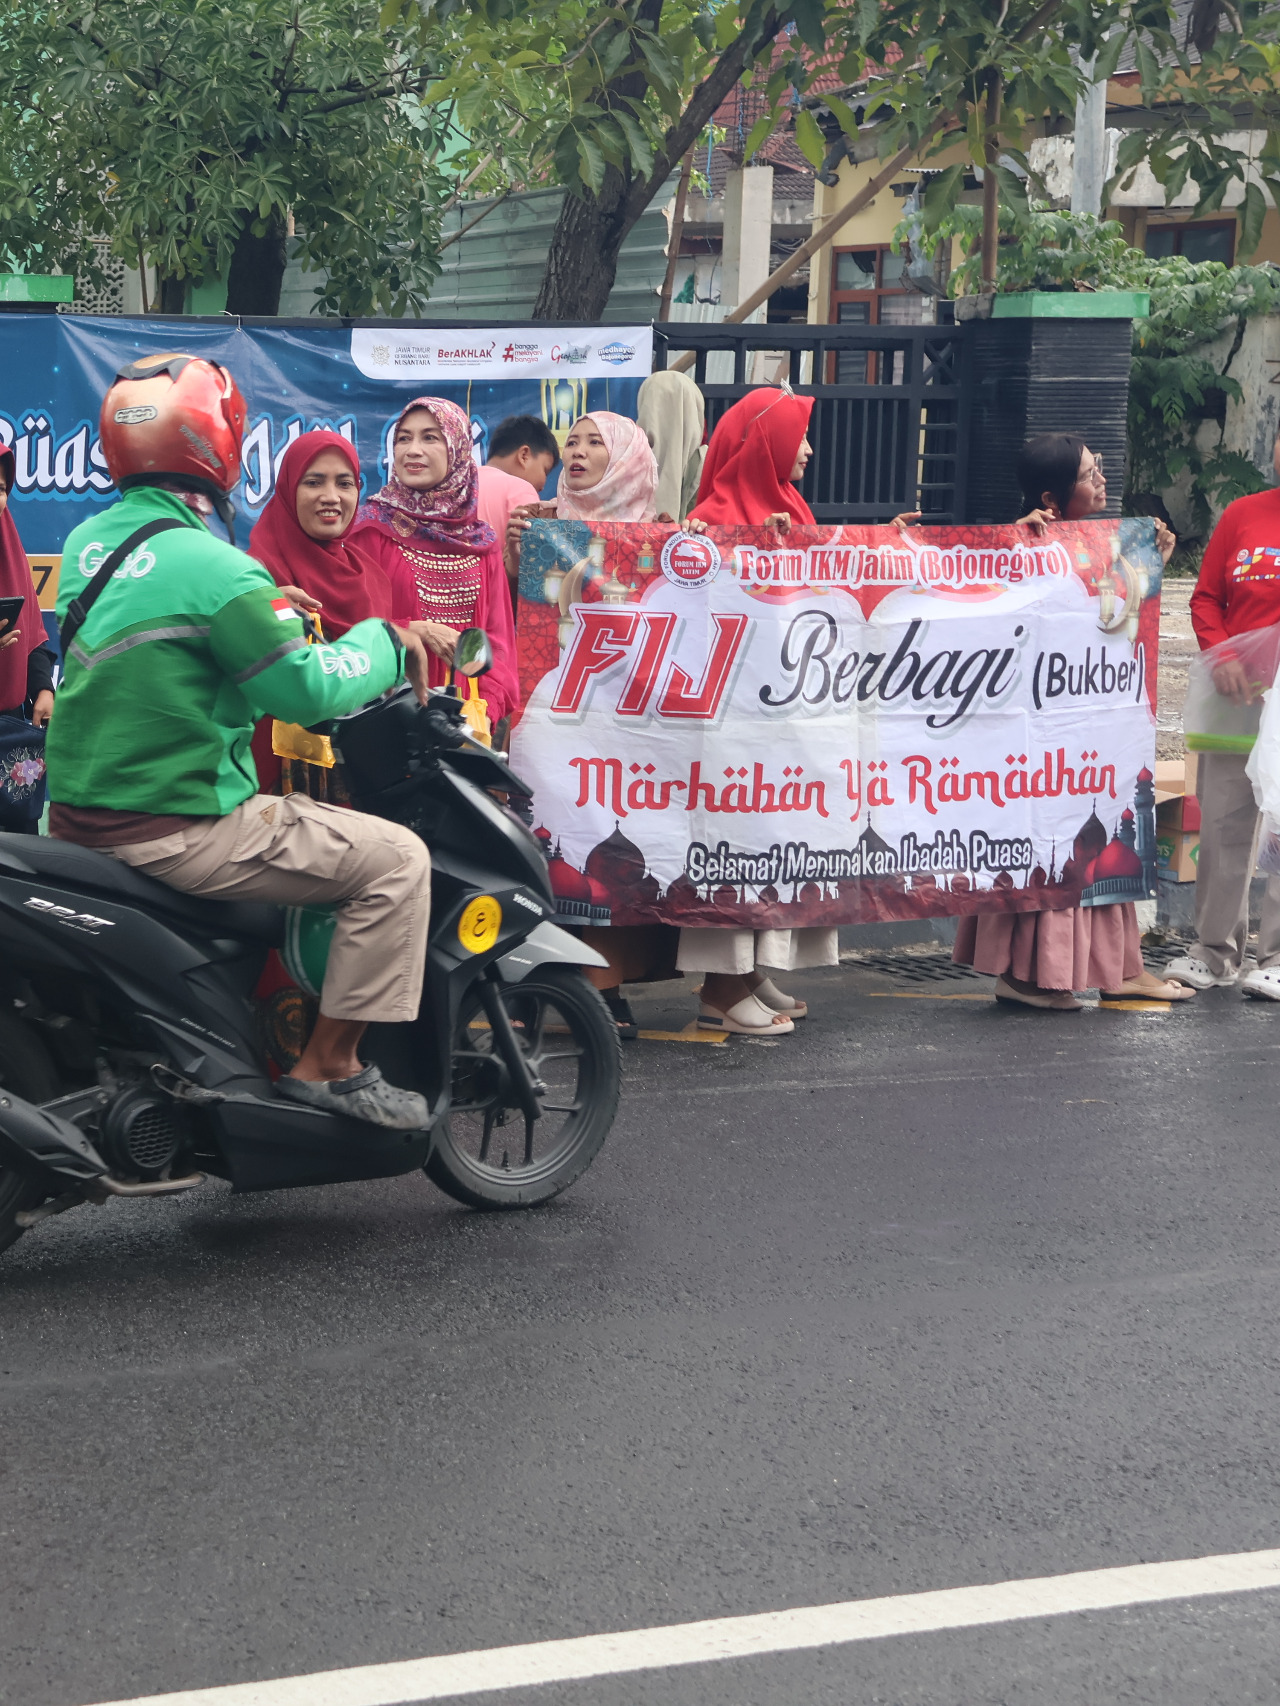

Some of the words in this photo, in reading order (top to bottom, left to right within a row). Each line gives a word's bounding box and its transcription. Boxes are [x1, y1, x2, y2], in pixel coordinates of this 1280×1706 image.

[437, 348, 493, 359] BerAKHLAK
[809, 549, 851, 581] IKM
[854, 548, 914, 585] Jatim
[919, 545, 1068, 585] (Bojonegoro)
[550, 612, 749, 719] FIJ
[759, 609, 1025, 729] Berbagi
[1031, 641, 1145, 710] (Bukber)
[688, 843, 782, 881] Selamat
[902, 833, 966, 872] Ibadah
[971, 833, 1033, 868] Puasa
[513, 893, 543, 916] HONDA
